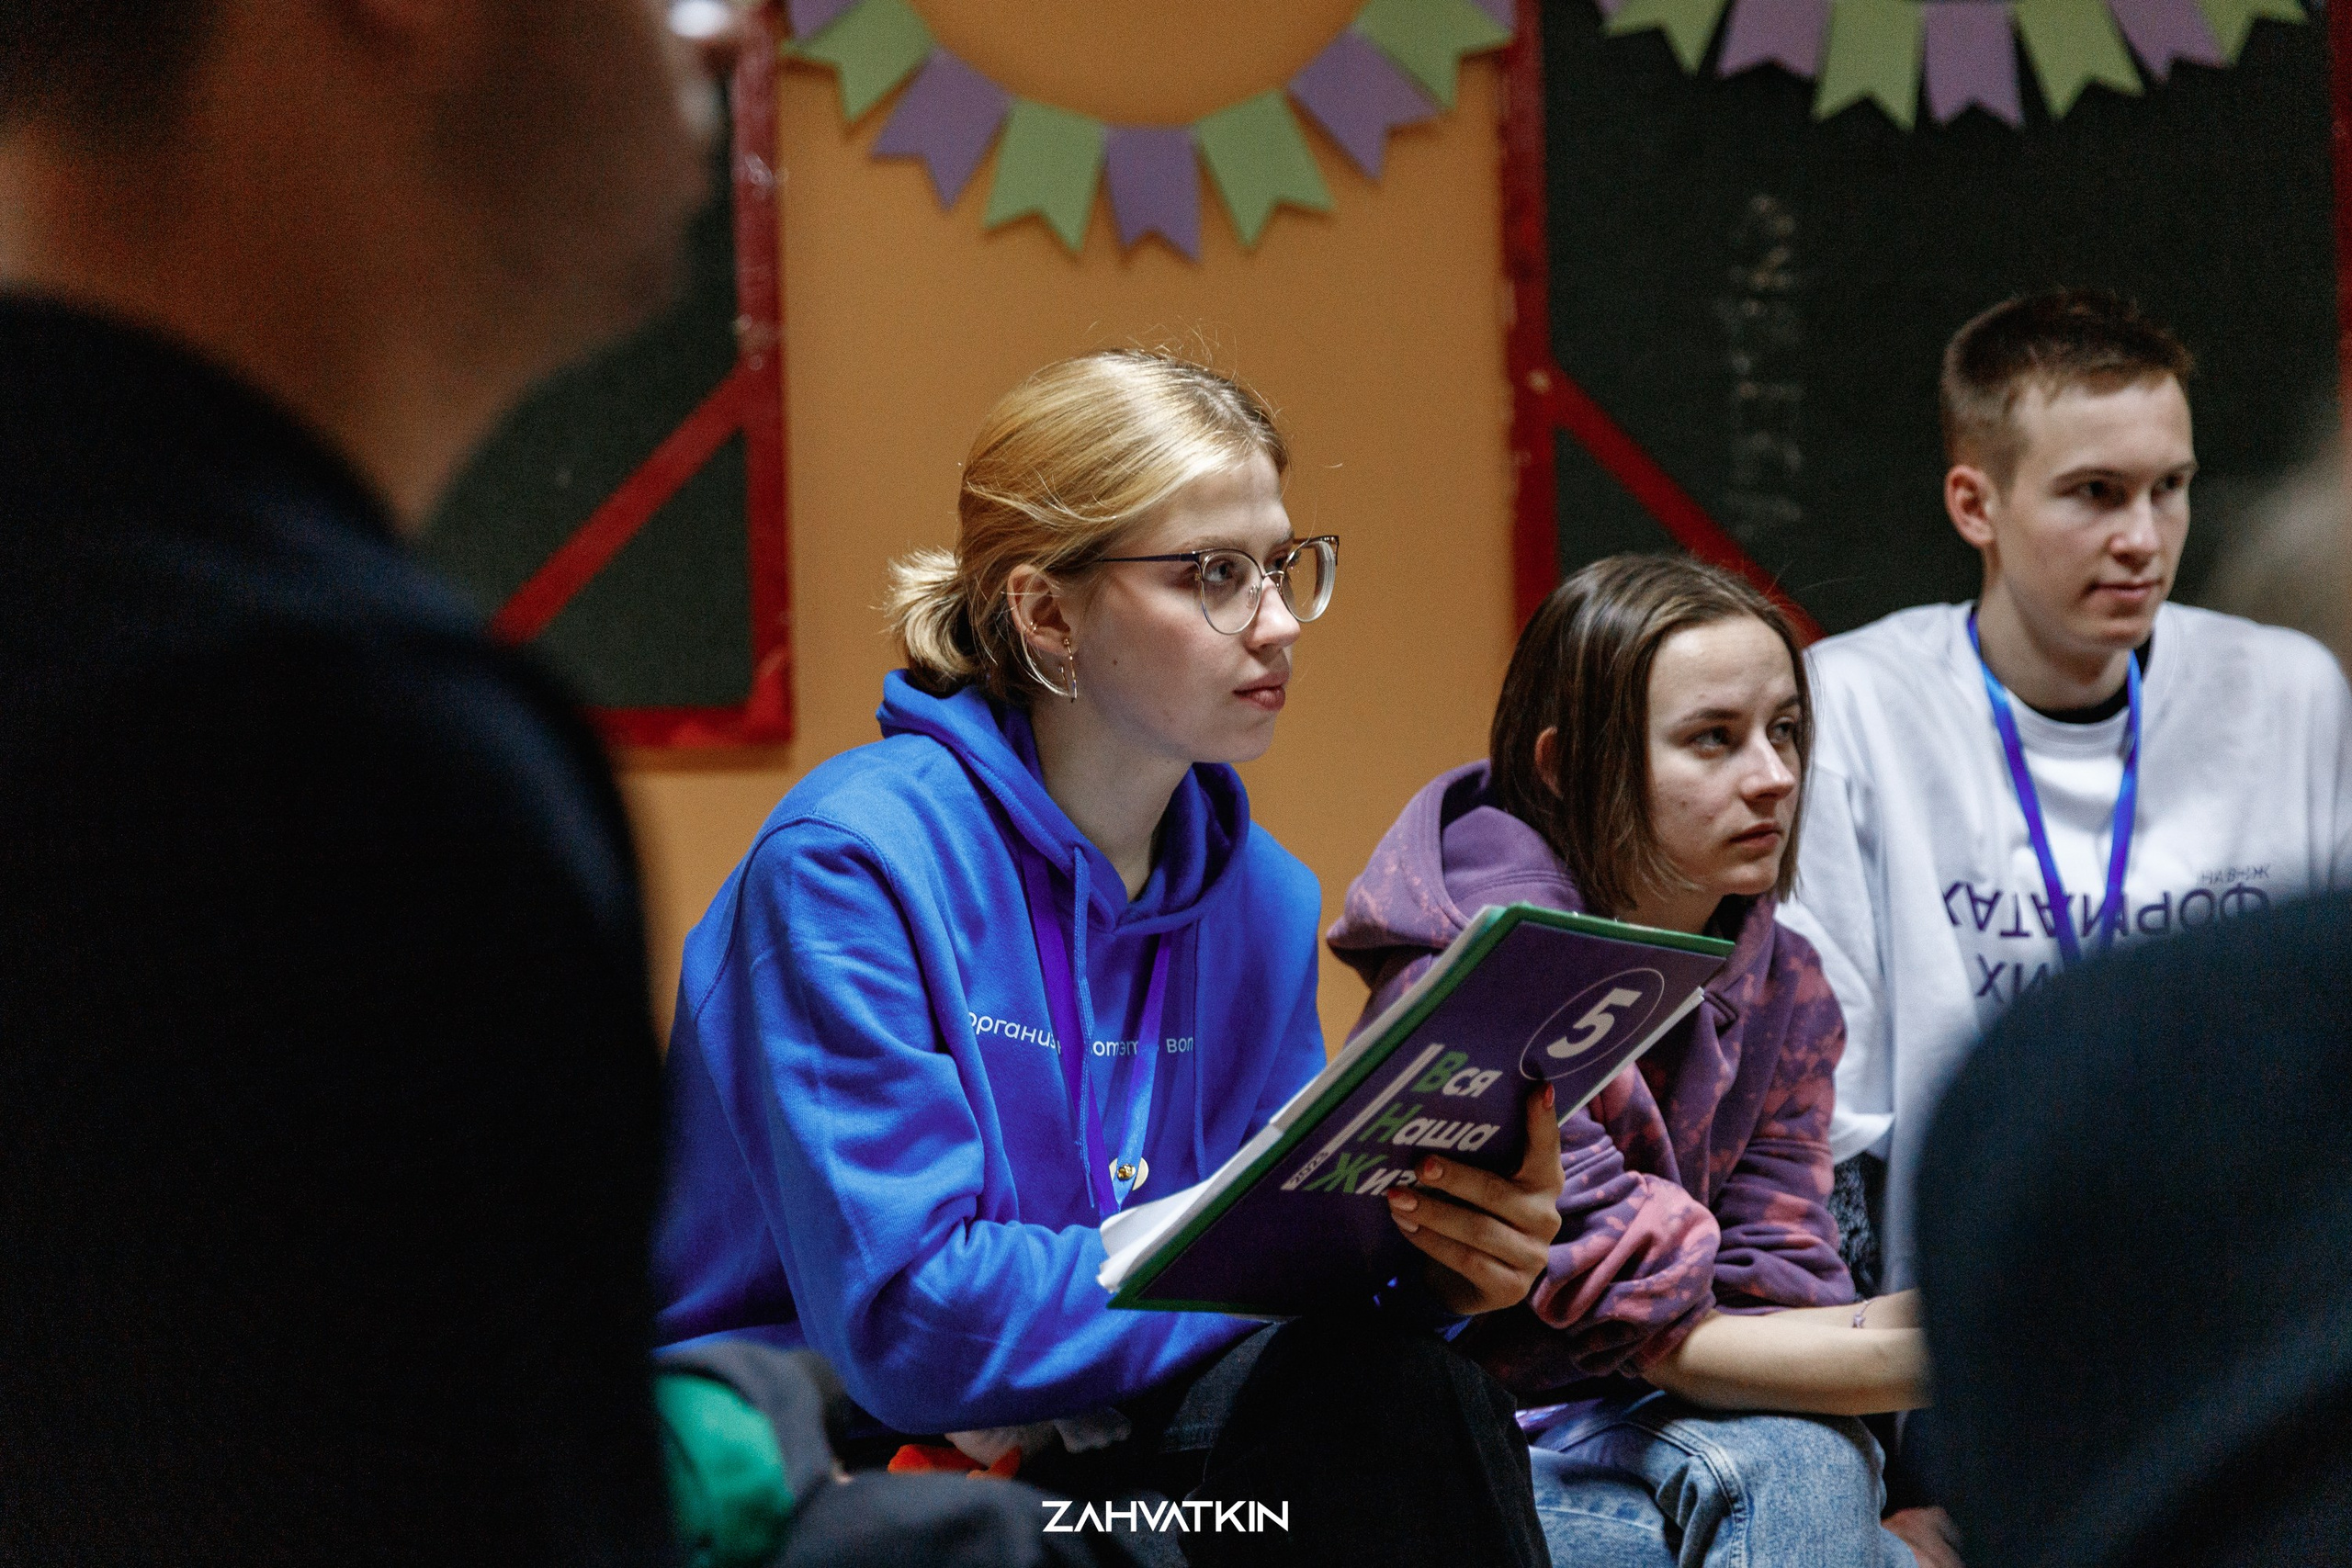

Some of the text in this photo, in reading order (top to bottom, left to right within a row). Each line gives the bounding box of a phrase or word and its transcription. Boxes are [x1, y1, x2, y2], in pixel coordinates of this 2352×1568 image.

[1547, 987, 1644, 1059] 5
[1411, 1050, 1503, 1098] Вся
[1356, 1102, 1501, 1152] Наша
